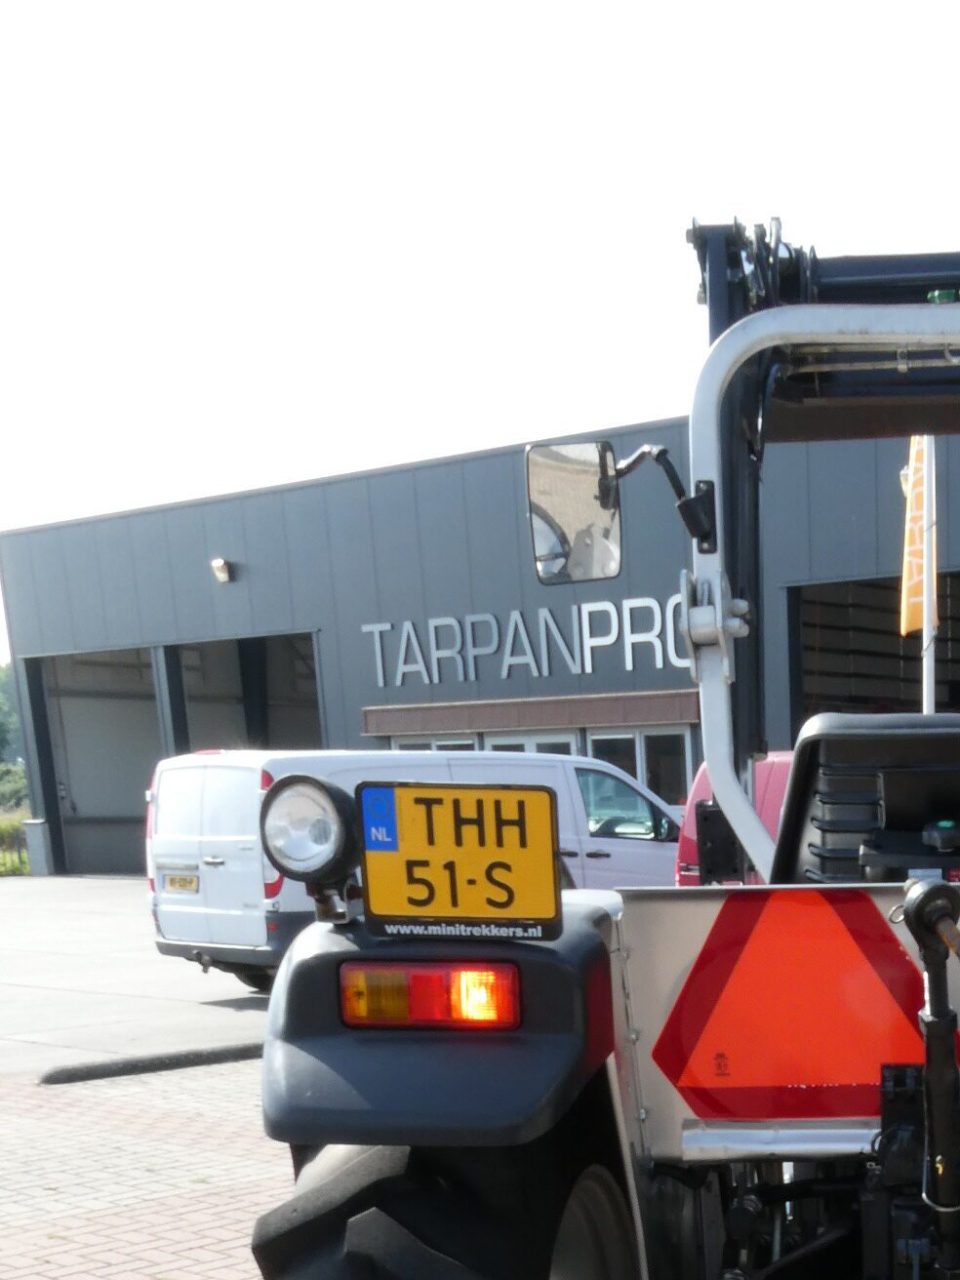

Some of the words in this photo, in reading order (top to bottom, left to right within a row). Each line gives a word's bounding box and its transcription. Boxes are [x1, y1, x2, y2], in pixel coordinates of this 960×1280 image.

[370, 827, 392, 842] NL
[413, 797, 528, 849] THH
[405, 860, 515, 910] 51-S
[385, 923, 542, 938] www.minitrekkers.nl
